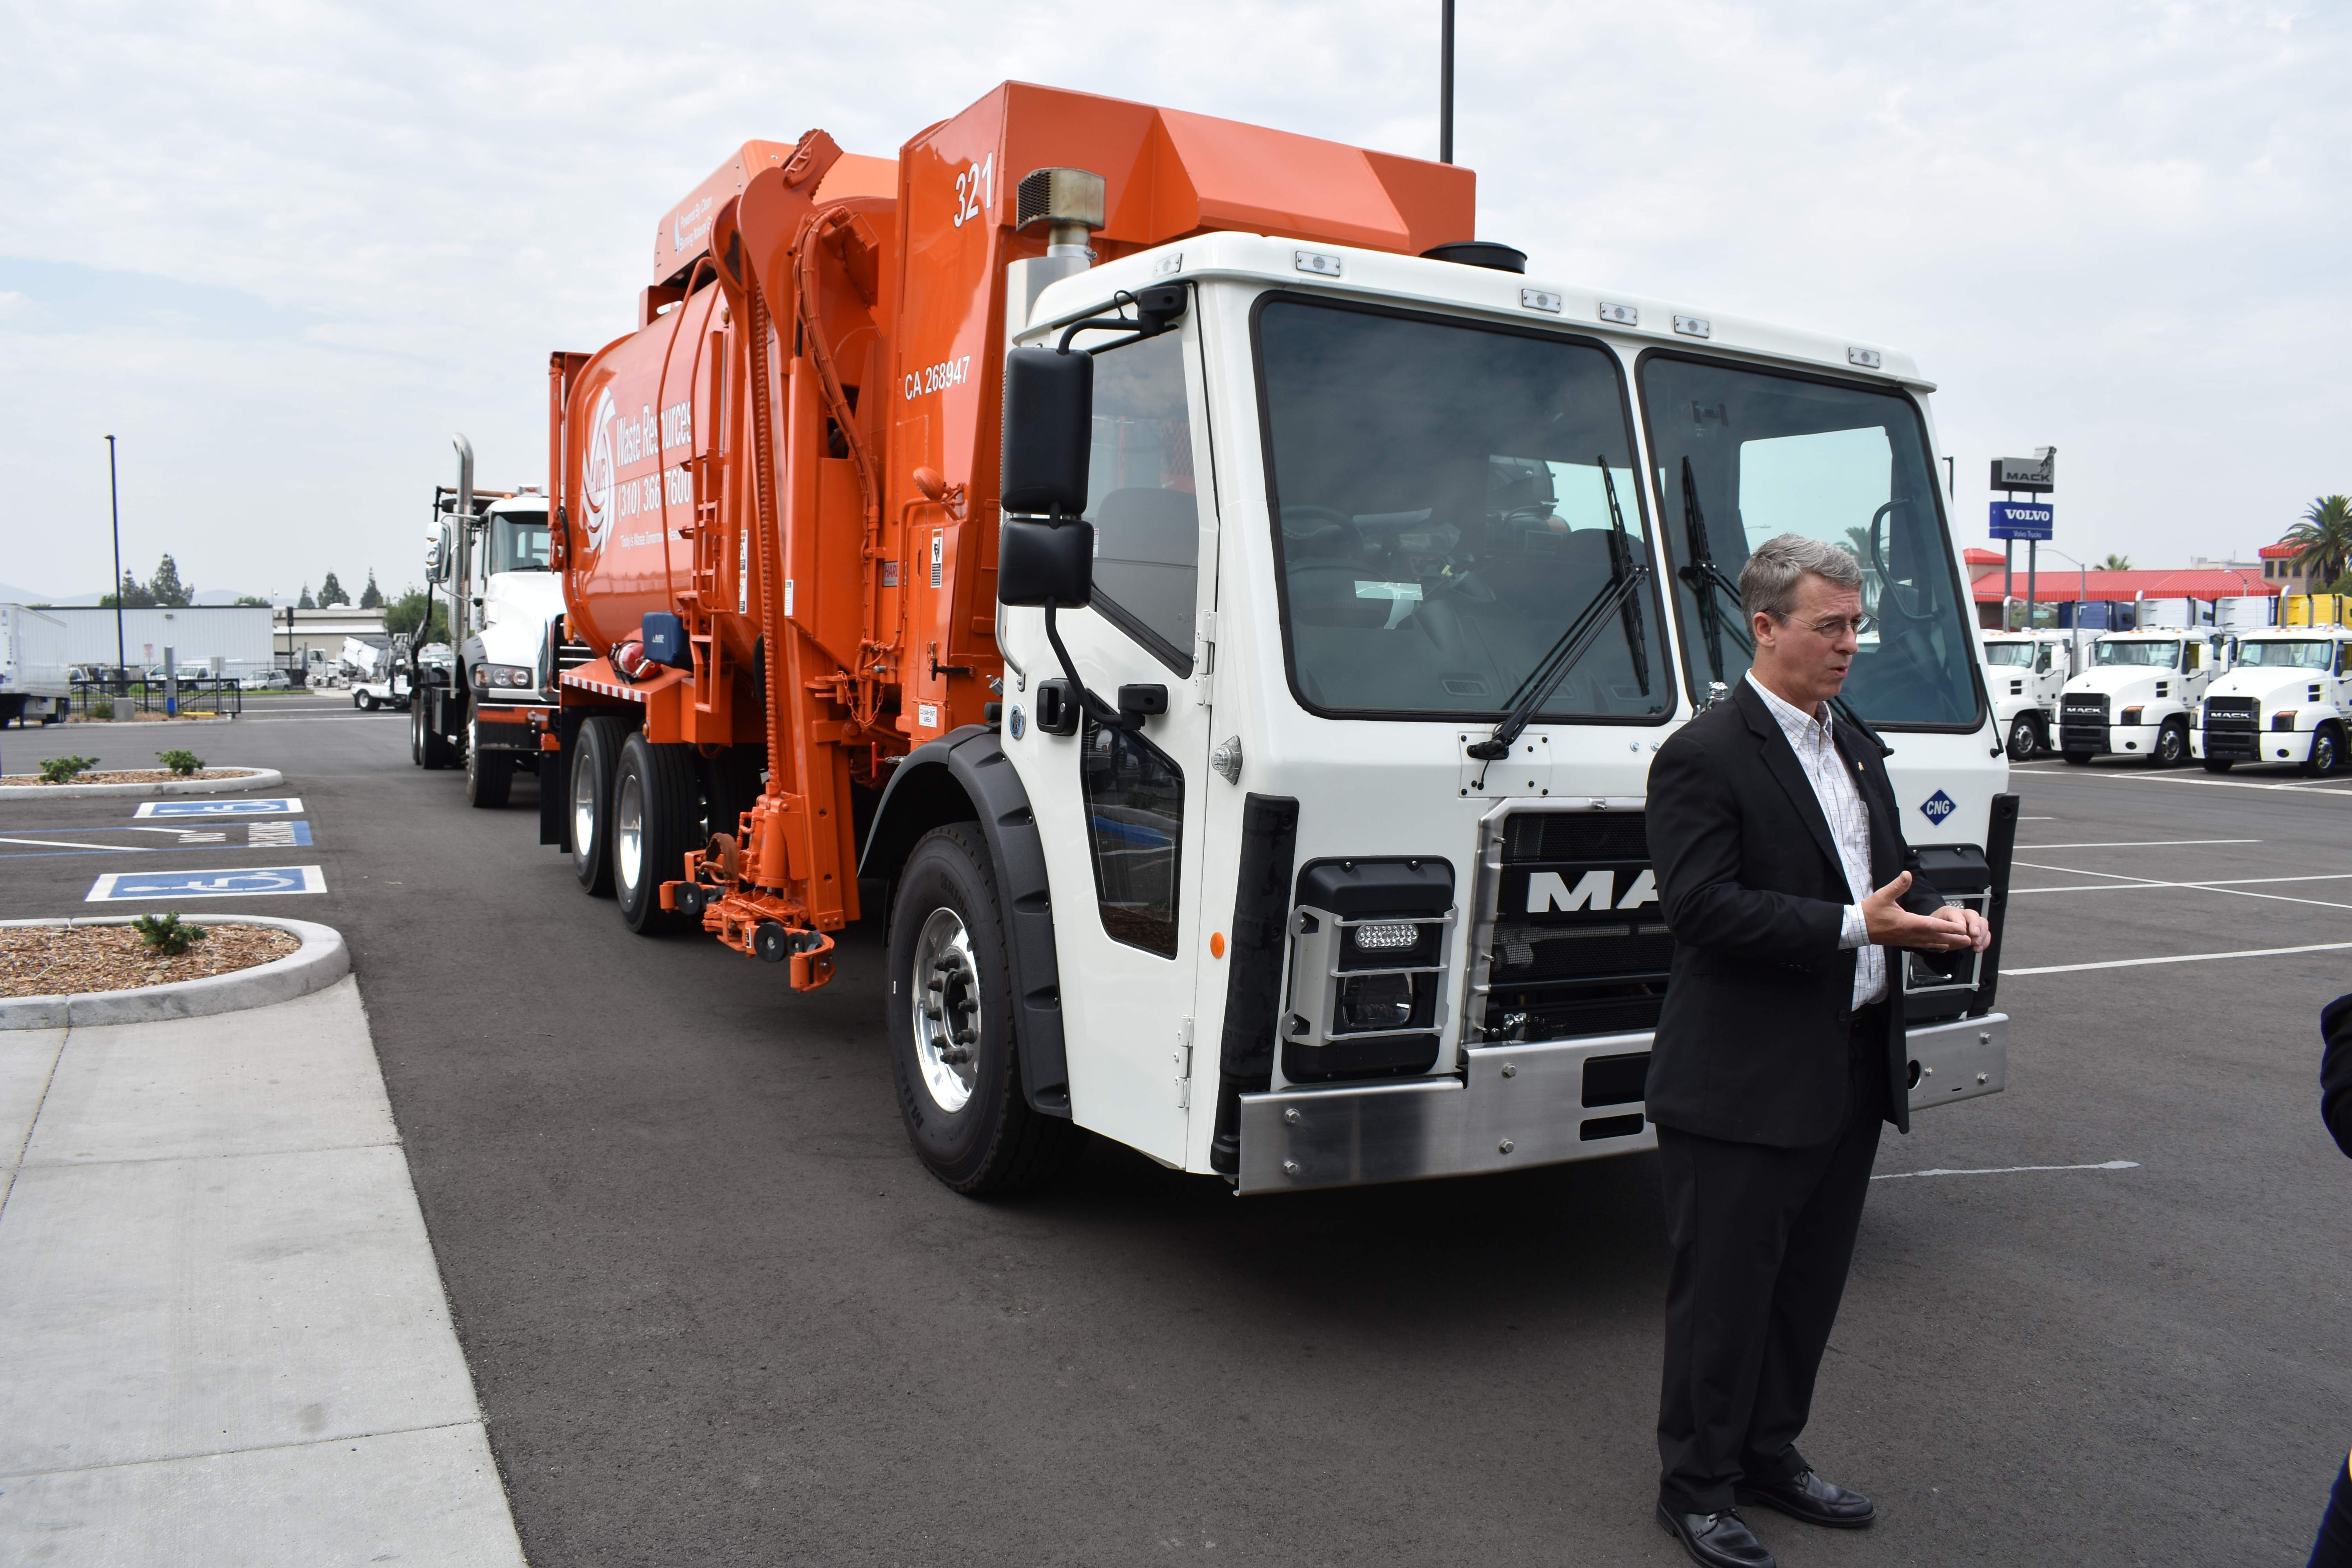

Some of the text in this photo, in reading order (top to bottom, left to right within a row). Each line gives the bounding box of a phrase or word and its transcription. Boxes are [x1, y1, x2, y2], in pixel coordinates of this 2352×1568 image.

[954, 151, 993, 228] 321
[905, 355, 970, 400] CA 268947
[617, 414, 641, 467] Waste
[2006, 472, 2051, 482] MACK
[618, 479, 641, 523] (310)
[2004, 509, 2050, 521] VOLVO
[2013, 530, 2042, 539] Volvo Trucks
[1926, 800, 1950, 815] CNG
[178, 832, 226, 843] NO
[248, 821, 297, 848] PARKING
[1525, 869, 1659, 913] MA
